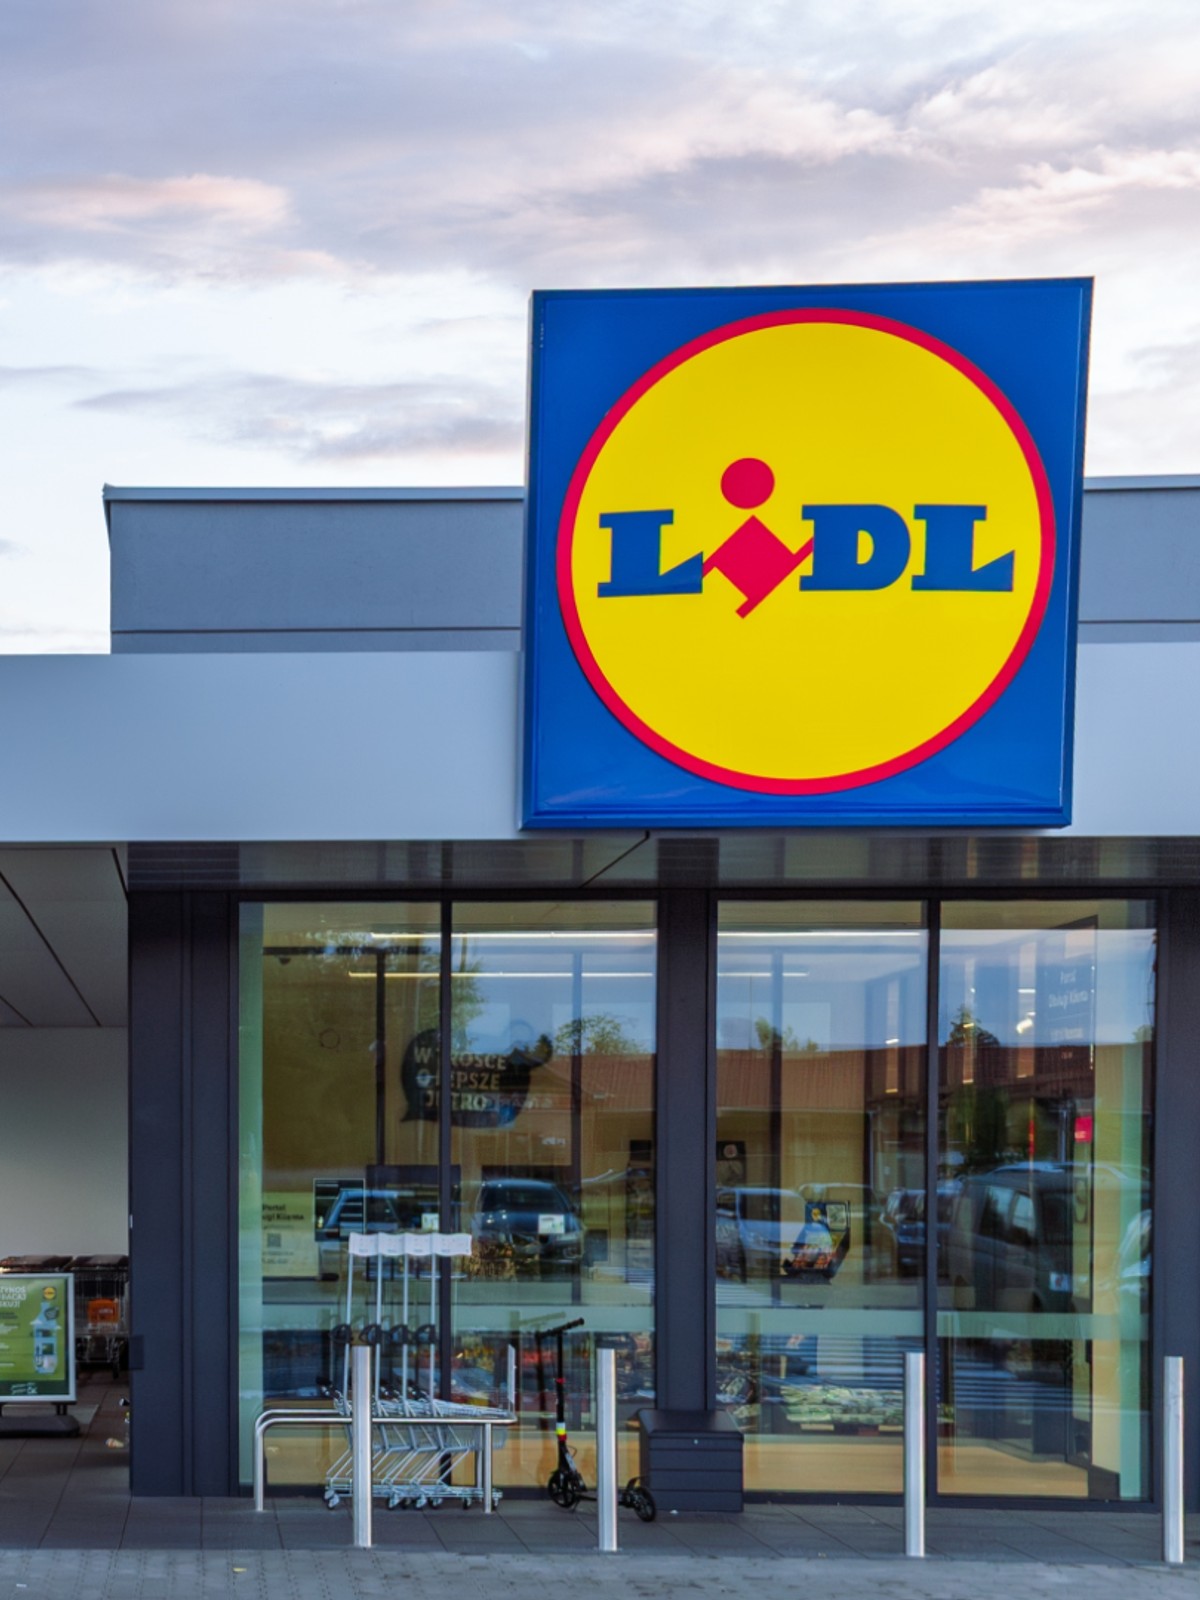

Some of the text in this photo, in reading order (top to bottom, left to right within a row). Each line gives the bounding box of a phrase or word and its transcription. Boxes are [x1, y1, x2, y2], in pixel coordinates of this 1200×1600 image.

[414, 1047, 431, 1064] W
[436, 1068, 499, 1090] PSZE
[425, 1090, 488, 1112] JTRO
